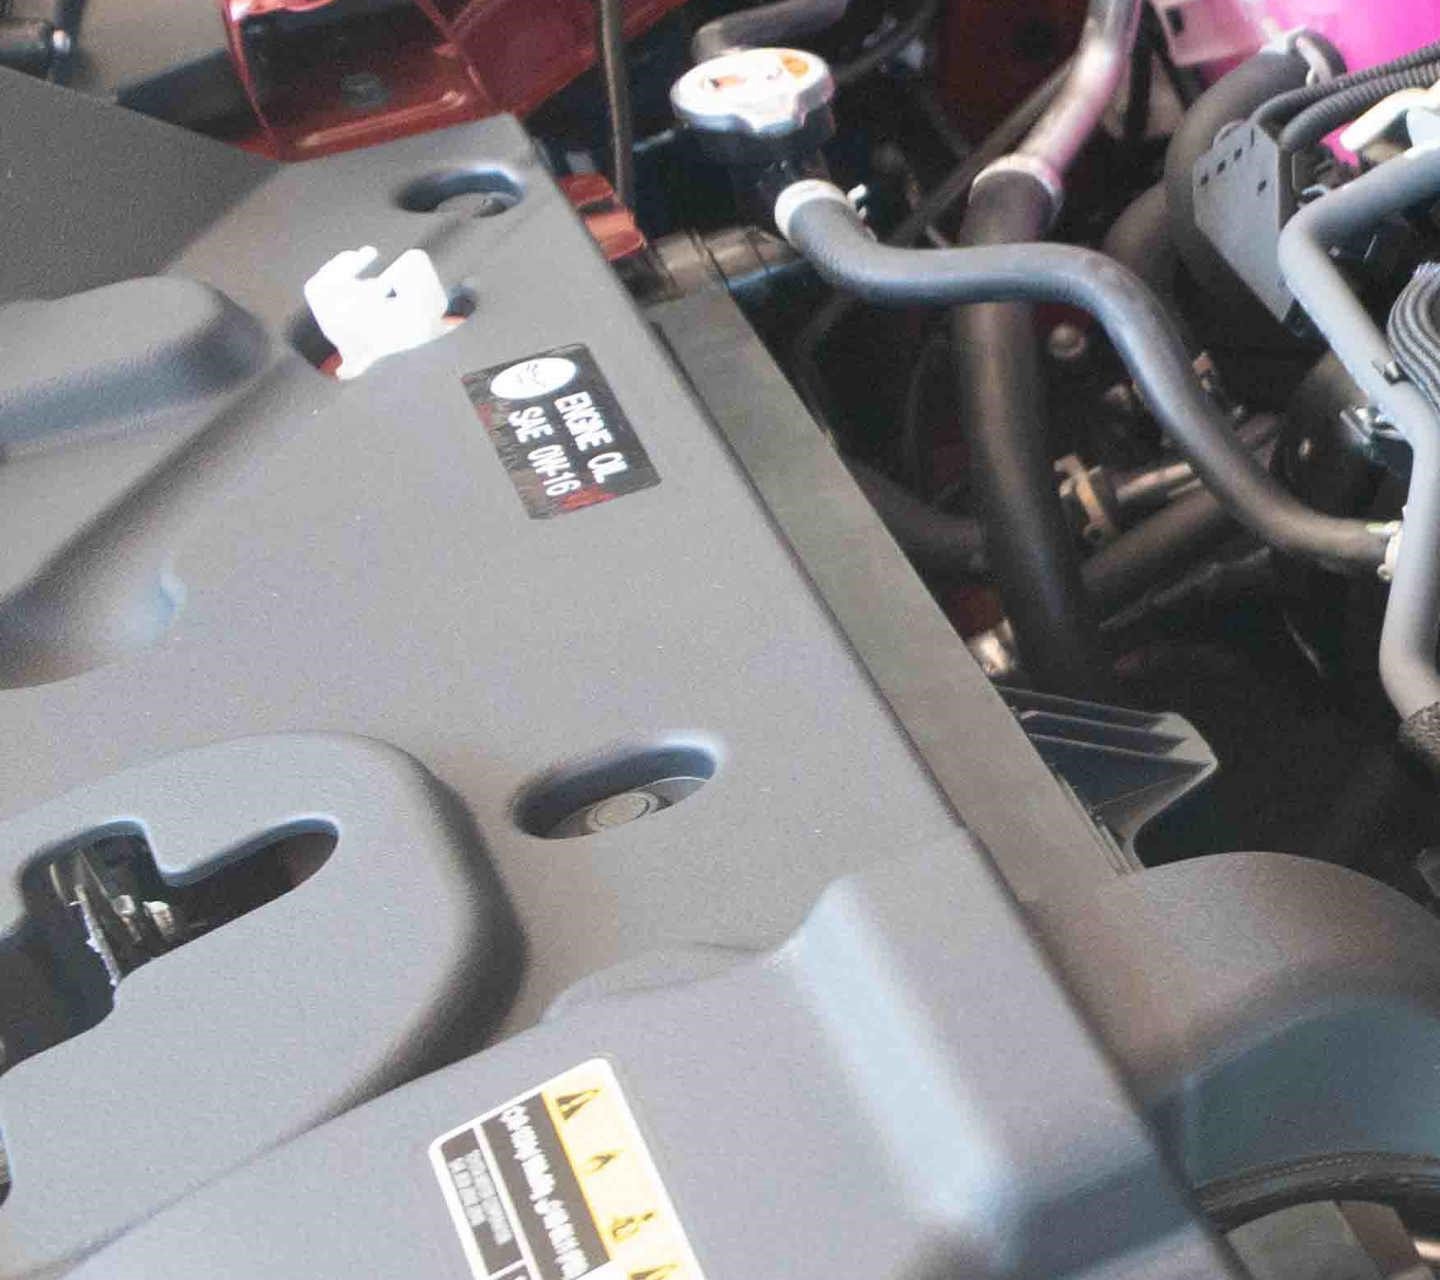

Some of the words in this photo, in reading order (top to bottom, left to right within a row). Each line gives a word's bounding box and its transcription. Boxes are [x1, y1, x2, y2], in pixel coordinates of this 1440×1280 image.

[507, 406, 553, 444] SAE
[554, 391, 613, 451] ENGINE
[587, 452, 627, 484] OIL
[527, 444, 582, 496] 0W-16
